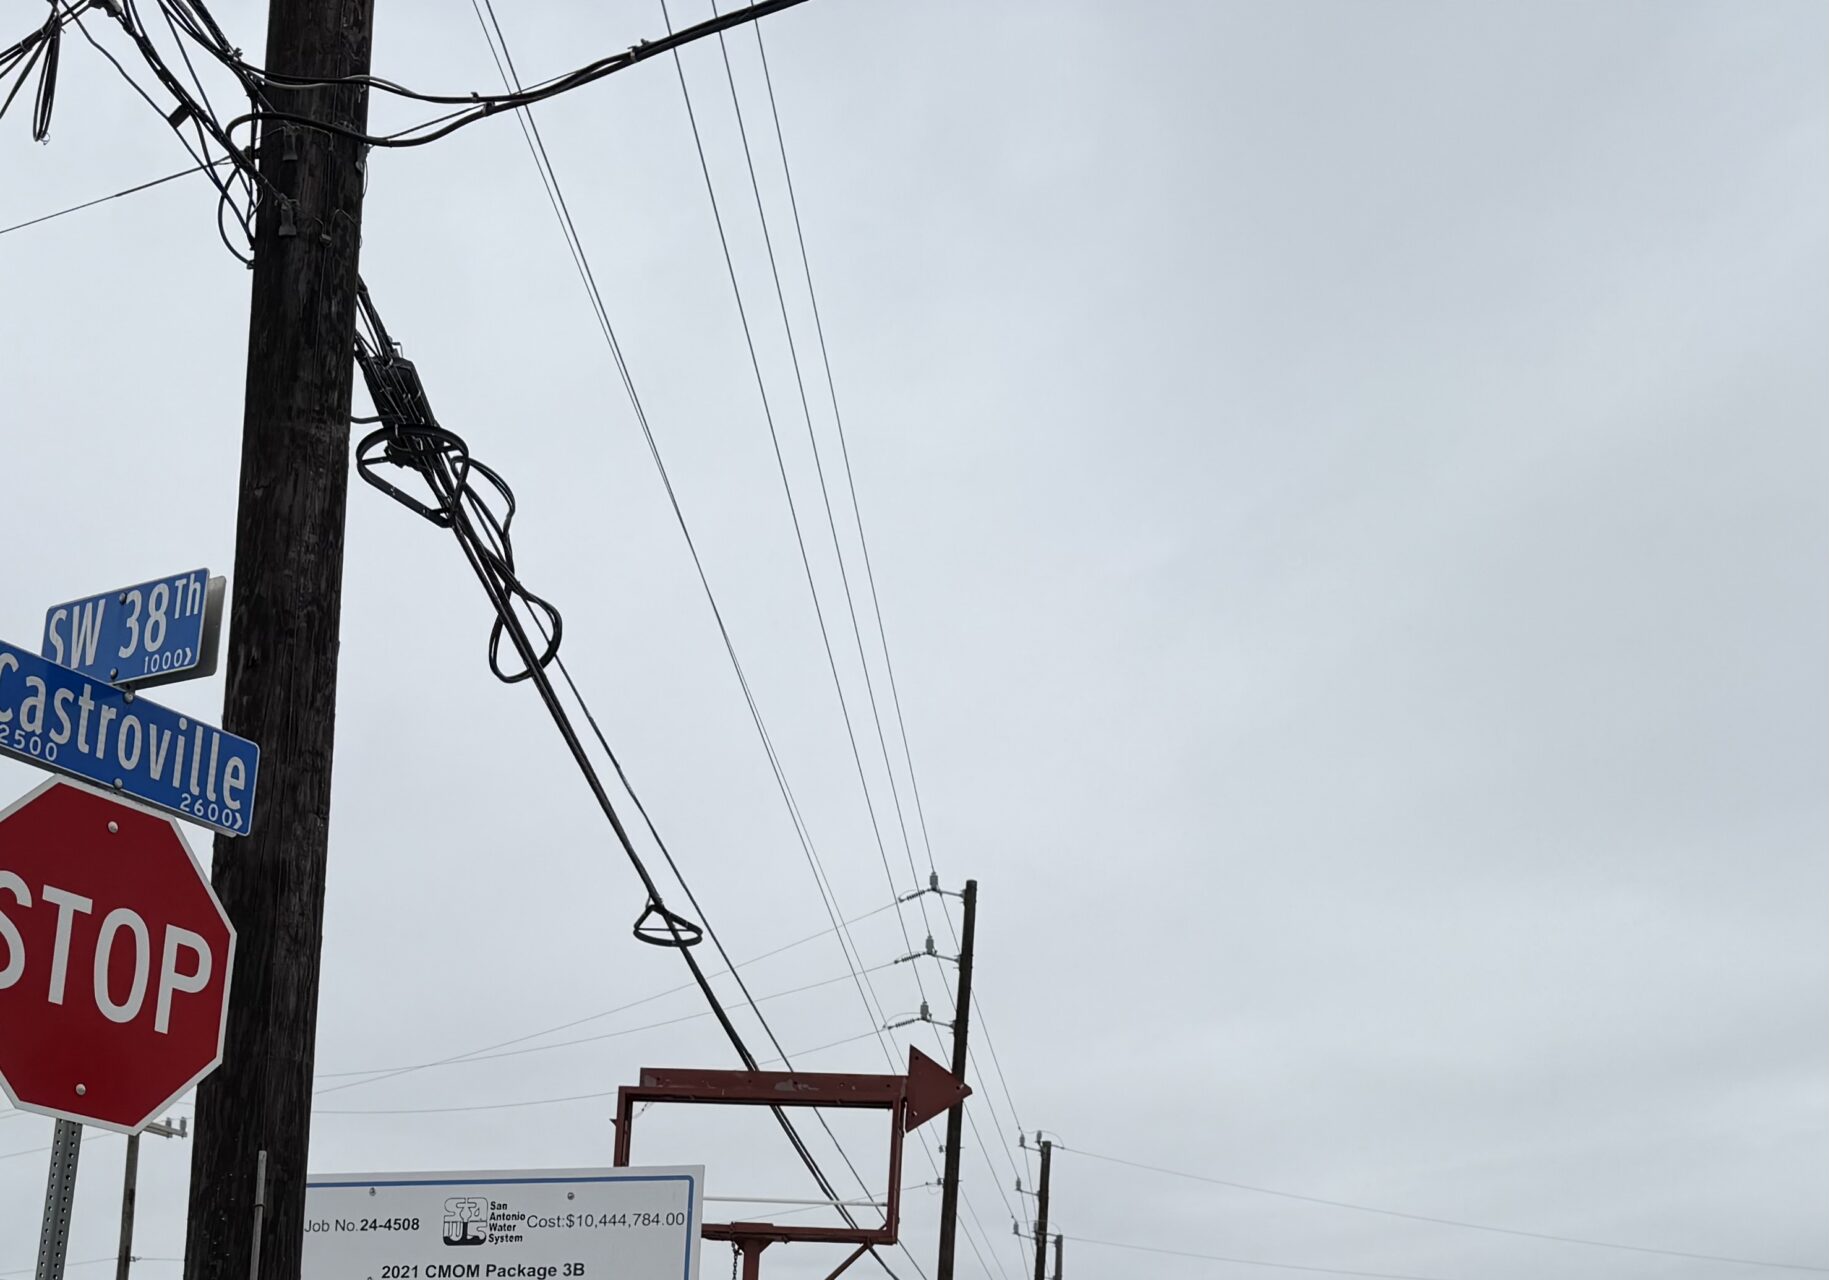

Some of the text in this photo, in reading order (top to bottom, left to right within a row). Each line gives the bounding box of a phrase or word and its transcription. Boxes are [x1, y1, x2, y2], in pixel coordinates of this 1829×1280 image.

[49, 598, 106, 670] SW
[143, 649, 183, 674] 1000
[0, 652, 246, 810] Castroville
[0, 724, 58, 762] 2500
[179, 793, 233, 827] 2600
[0, 869, 213, 1035] STOP
[489, 1201, 508, 1211] San
[489, 1211, 526, 1221] Antonio
[304, 1219, 330, 1233] Job
[489, 1222, 517, 1232] Water
[488, 1233, 523, 1245] System
[381, 1262, 585, 1280] 2021 CMOM Package 3B
